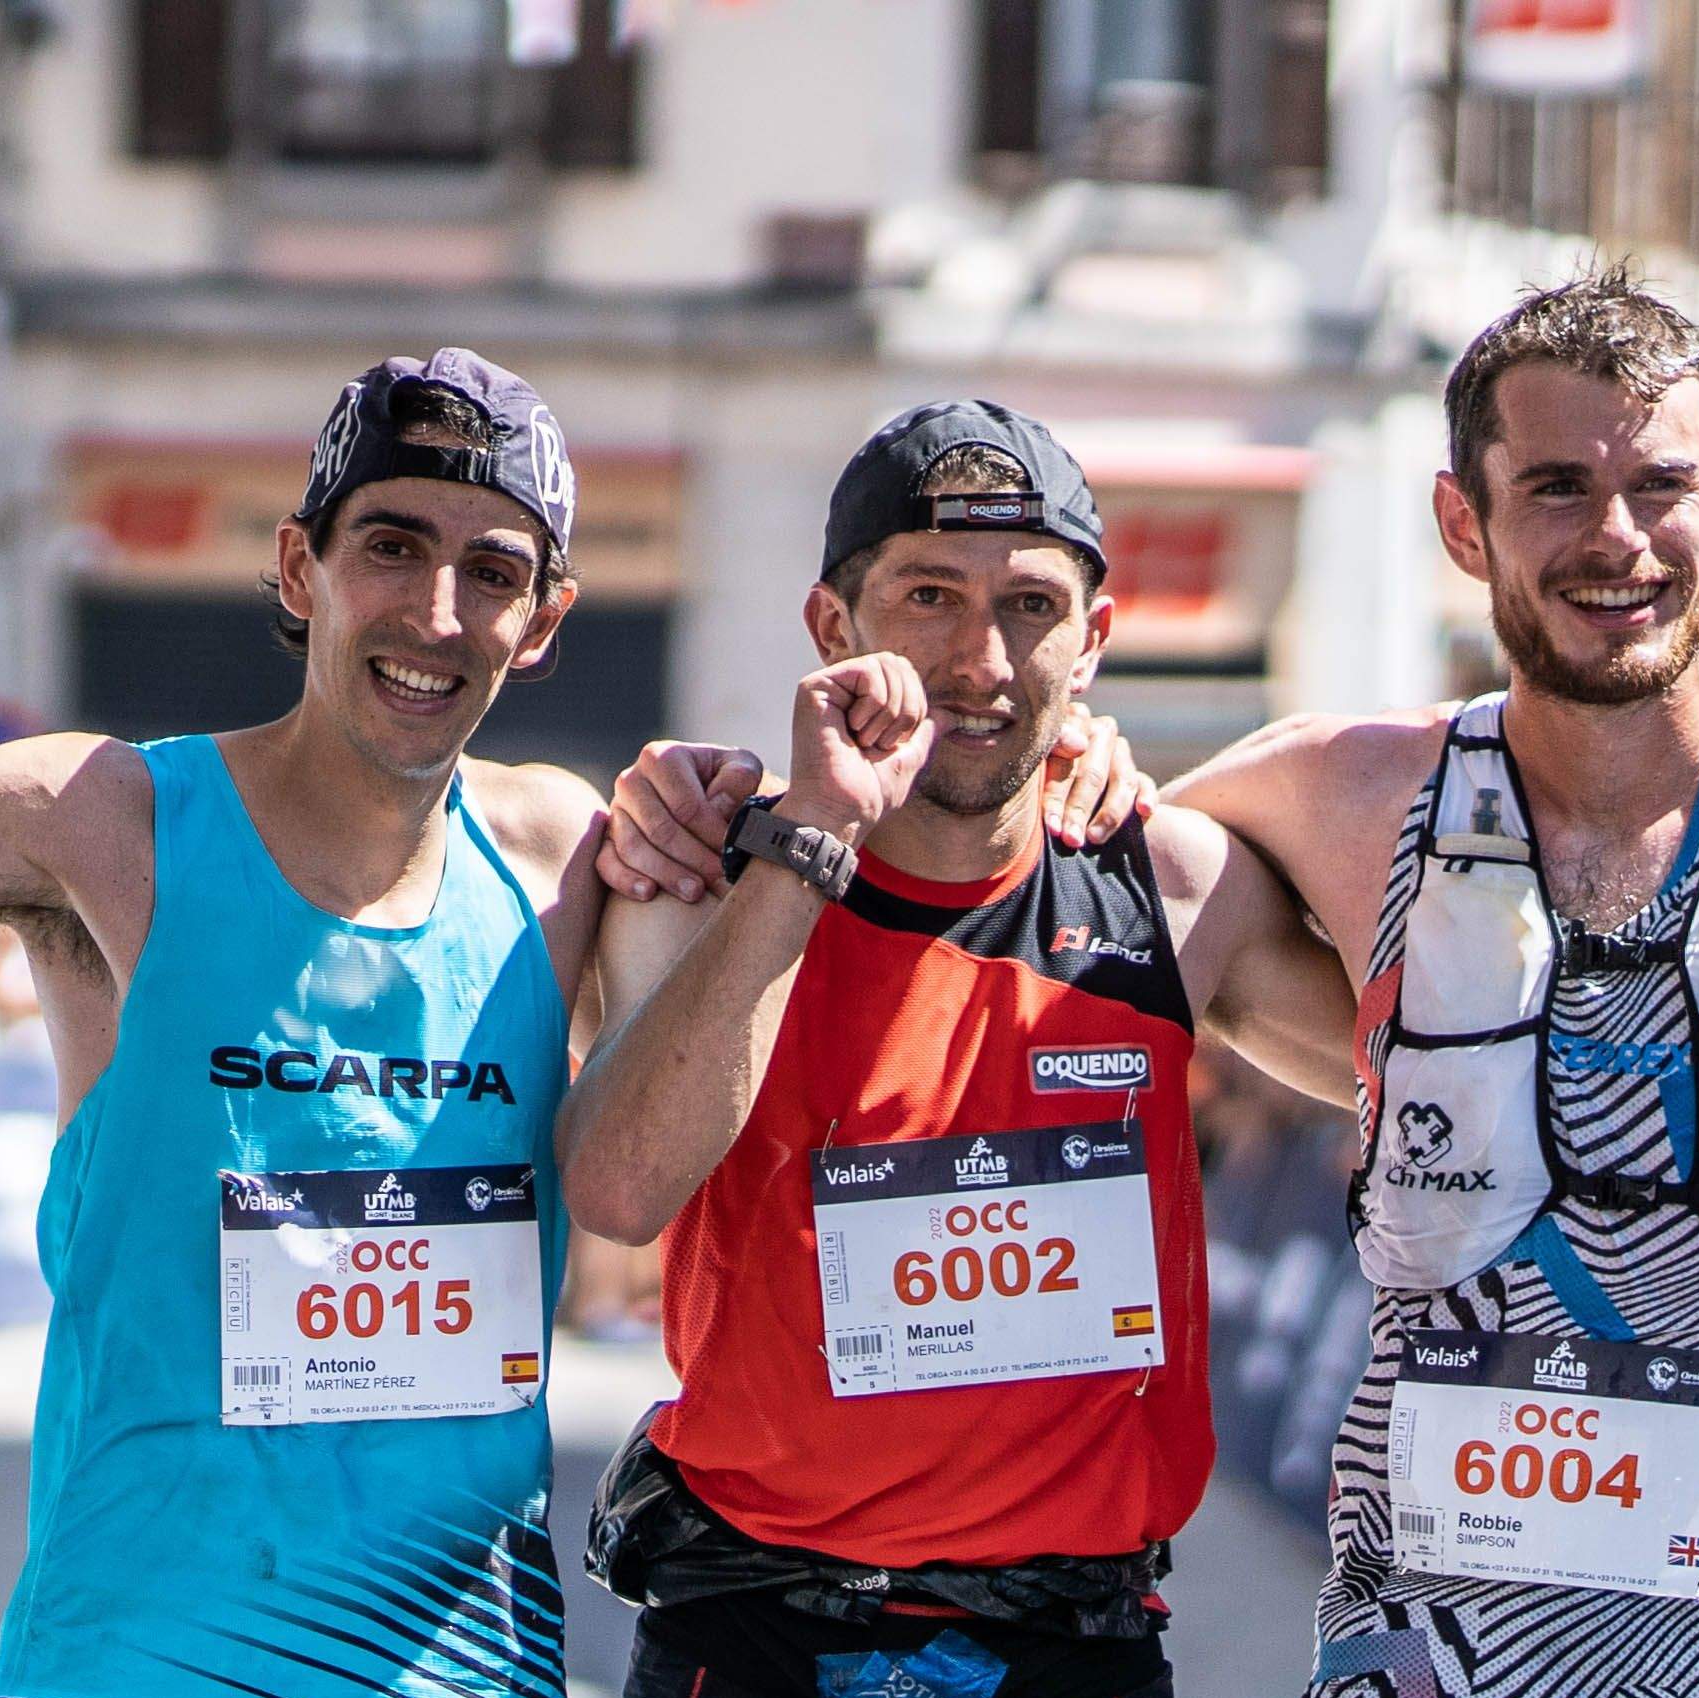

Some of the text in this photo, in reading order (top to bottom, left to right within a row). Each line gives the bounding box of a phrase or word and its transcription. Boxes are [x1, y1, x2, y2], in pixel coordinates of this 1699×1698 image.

[969, 504, 1022, 517] OQUENDO
[209, 1045, 517, 1105] SCARPA
[1035, 1052, 1147, 1080] OQUENDO
[825, 1163, 886, 1185] Valais
[954, 1155, 1007, 1175] UTMB
[236, 1188, 296, 1211] Valais
[364, 1192, 416, 1210] UTMB
[929, 1207, 942, 1240] 2022
[945, 1200, 1028, 1236] OCC
[351, 1239, 430, 1272] OCC
[893, 1237, 1079, 1306] 6002
[296, 1279, 473, 1339] 6015
[907, 1319, 974, 1340] Manuel
[907, 1340, 974, 1357] MERILLAS
[1415, 1347, 1469, 1367] Valais
[305, 1357, 376, 1374] Antonio
[1534, 1358, 1587, 1378] UTMB
[305, 1374, 416, 1391] MARTÍNEZ PÉREZ
[1498, 1401, 1511, 1433] 2022
[1514, 1403, 1600, 1440] OCC
[1454, 1440, 1642, 1508] 6004
[1458, 1512, 1522, 1532] Robbie
[1456, 1533, 1516, 1548] SIMPSON
